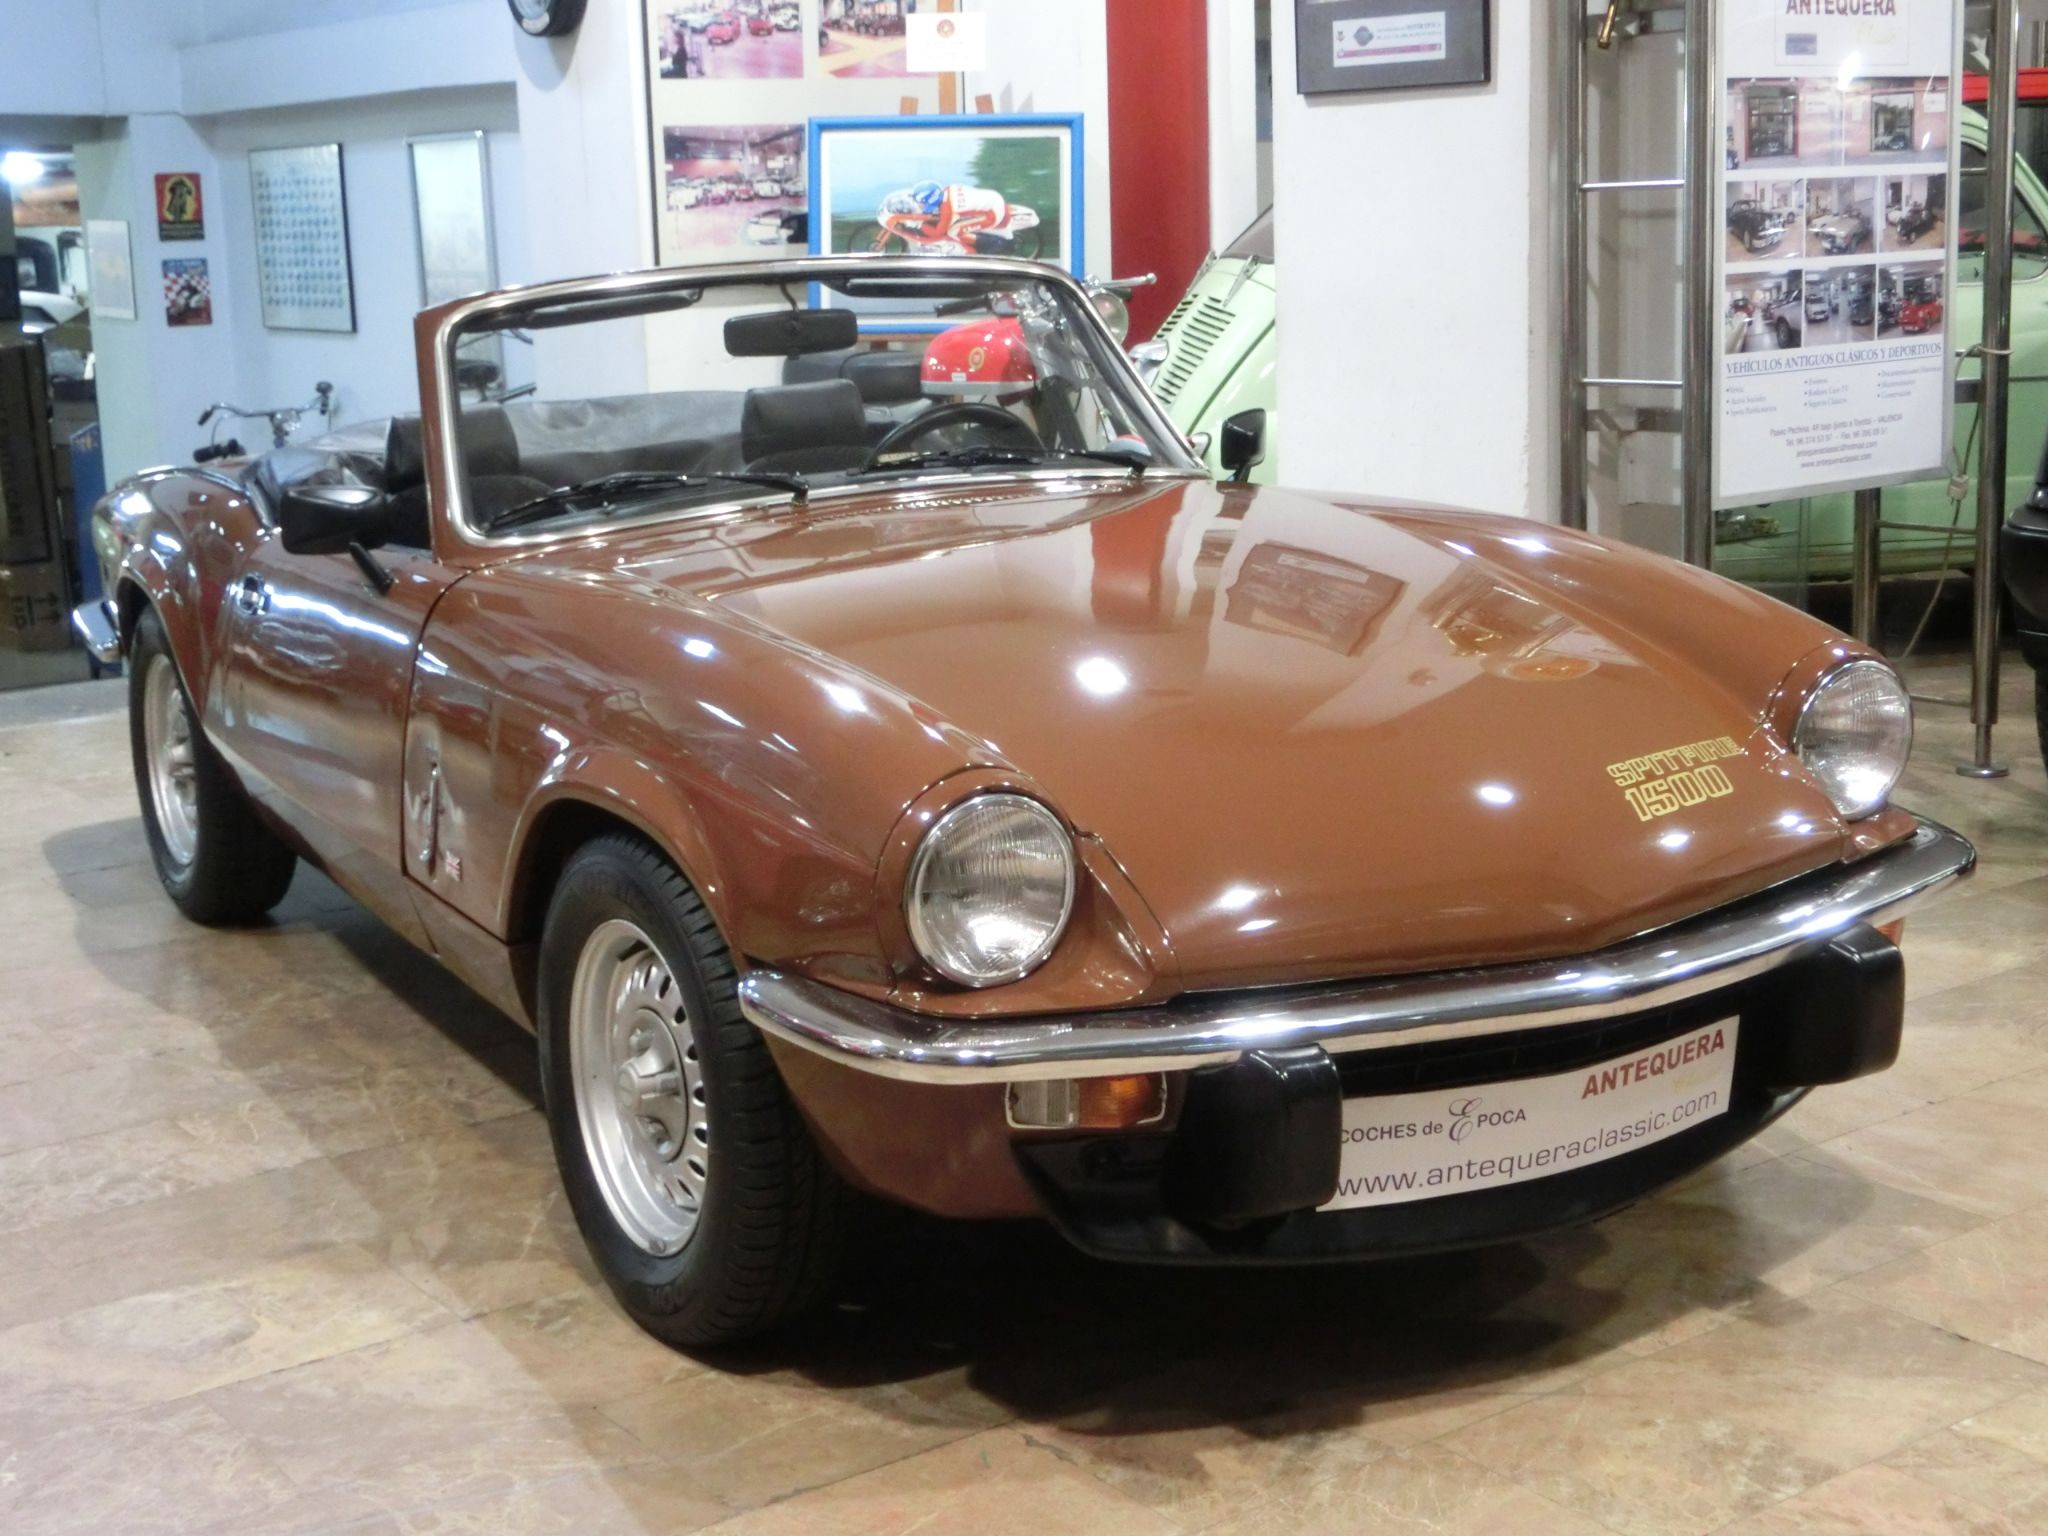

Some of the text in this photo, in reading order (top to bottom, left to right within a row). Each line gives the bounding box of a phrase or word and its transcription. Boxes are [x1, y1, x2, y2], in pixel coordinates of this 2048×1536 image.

[1785, 0, 1897, 16] ANTEQUERA
[1784, 353, 1834, 368] ANTIGUOS
[1880, 348, 1887, 359] Y
[1889, 342, 1942, 358] DEPORTIVOS
[1606, 736, 1743, 786] SPITFIRE
[1625, 764, 1734, 822] 1500
[1581, 1029, 1725, 1100] ANTEQUERA
[1338, 1090, 1717, 1196] www.antequeraclassic.com
[1422, 1121, 1443, 1136] de
